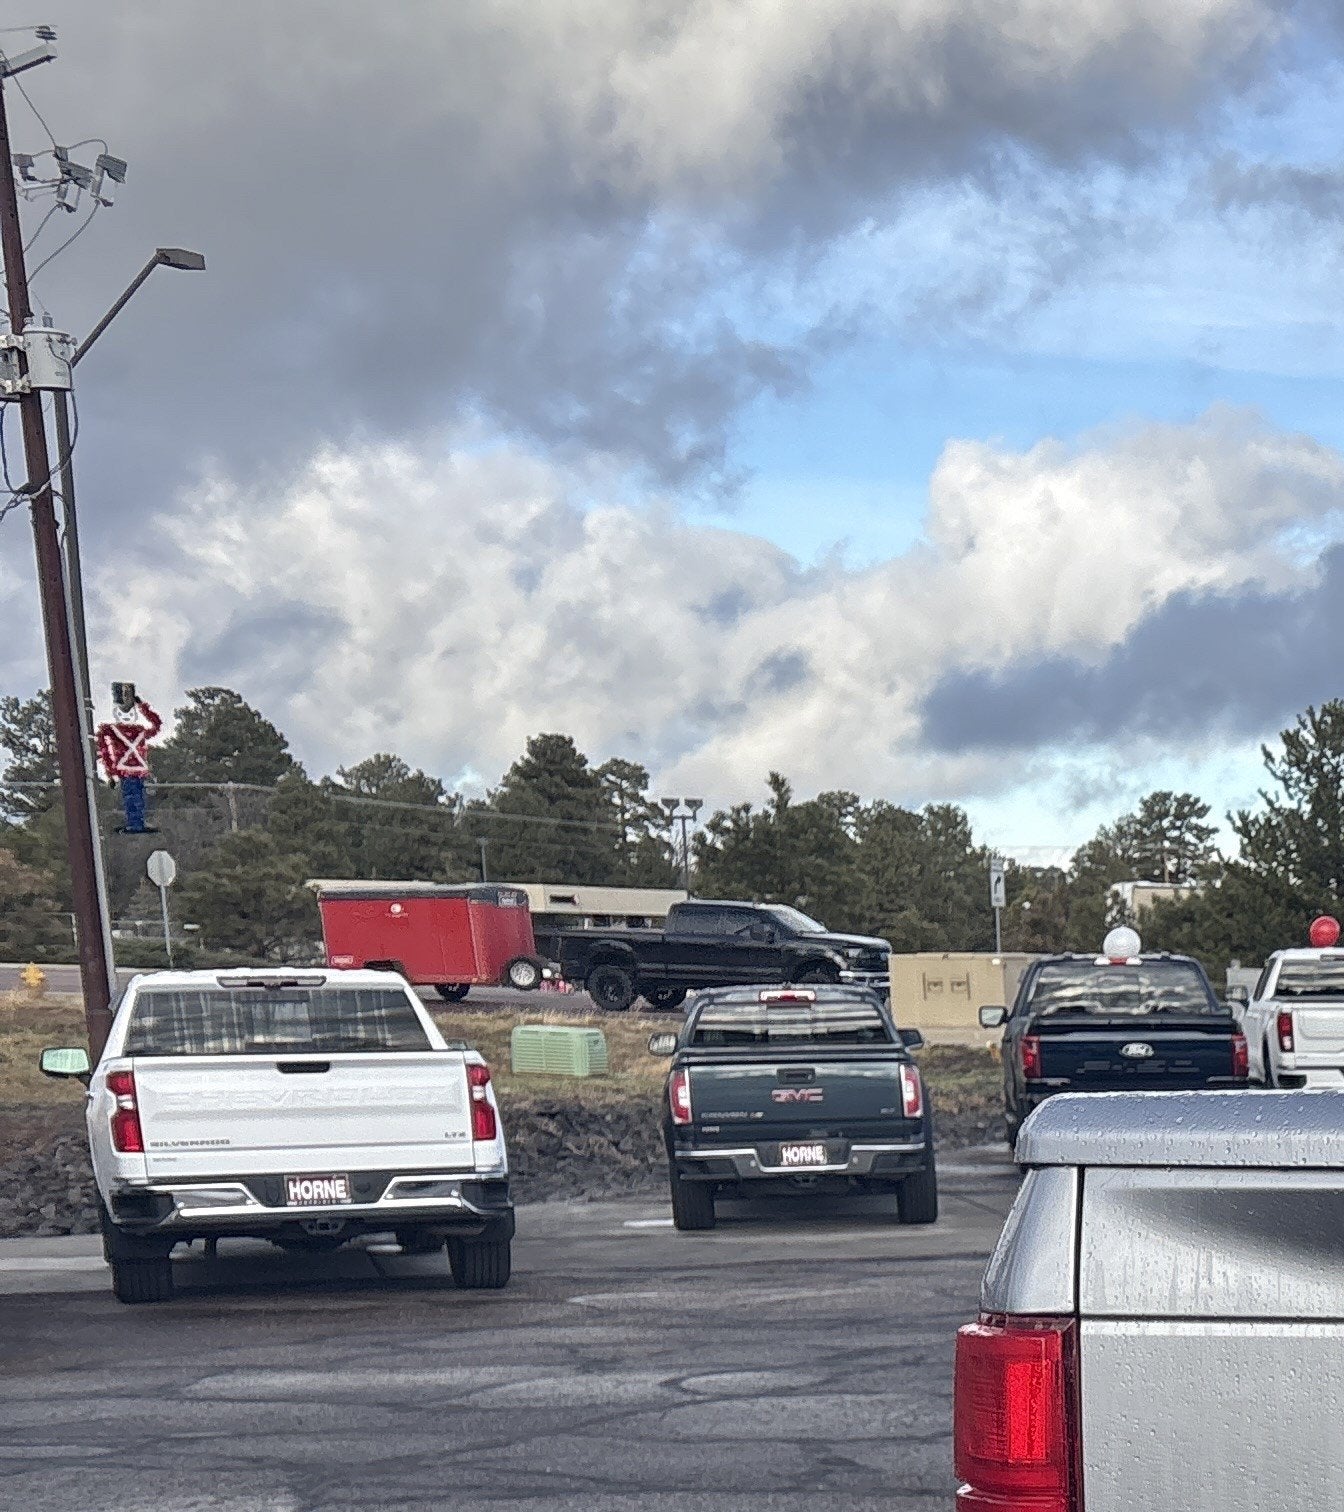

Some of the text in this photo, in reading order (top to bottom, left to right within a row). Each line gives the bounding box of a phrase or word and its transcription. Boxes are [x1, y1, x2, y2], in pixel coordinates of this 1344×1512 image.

[771, 1087, 824, 1103] GMC
[781, 1145, 825, 1163] HORNE
[288, 1178, 347, 1200] HORNE
